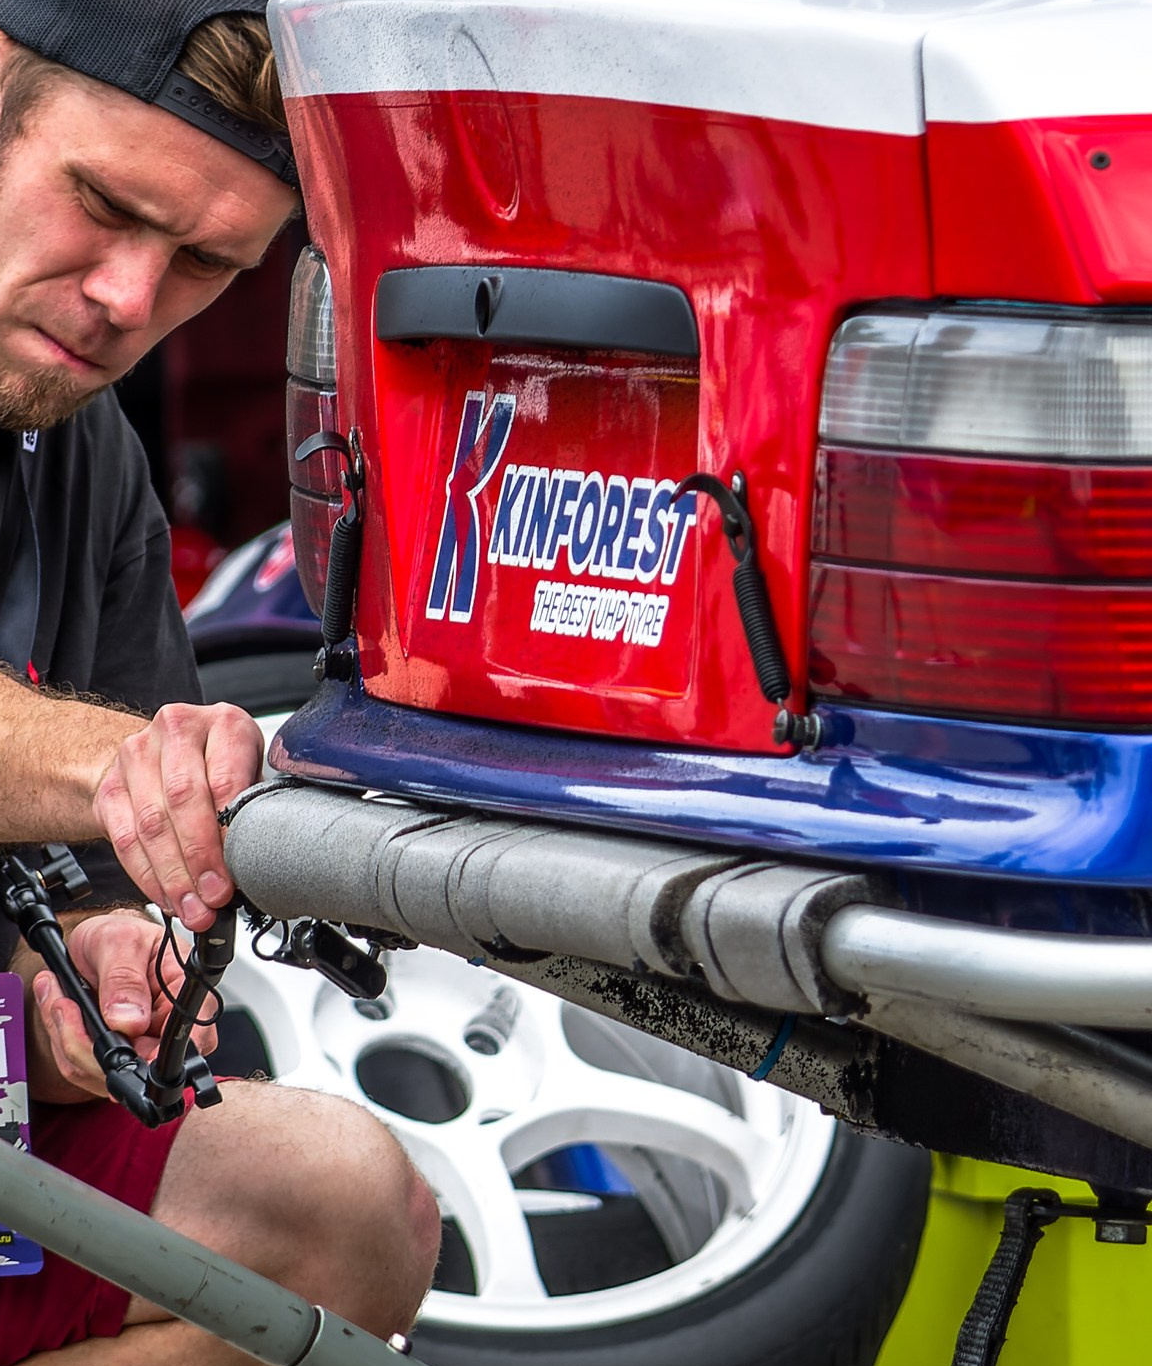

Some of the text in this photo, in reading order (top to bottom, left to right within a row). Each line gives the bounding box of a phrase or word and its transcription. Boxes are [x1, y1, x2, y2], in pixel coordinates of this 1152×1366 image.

[489, 467, 697, 579] KINFOREST
[533, 589, 665, 637] THE BEST UHP TYRE
